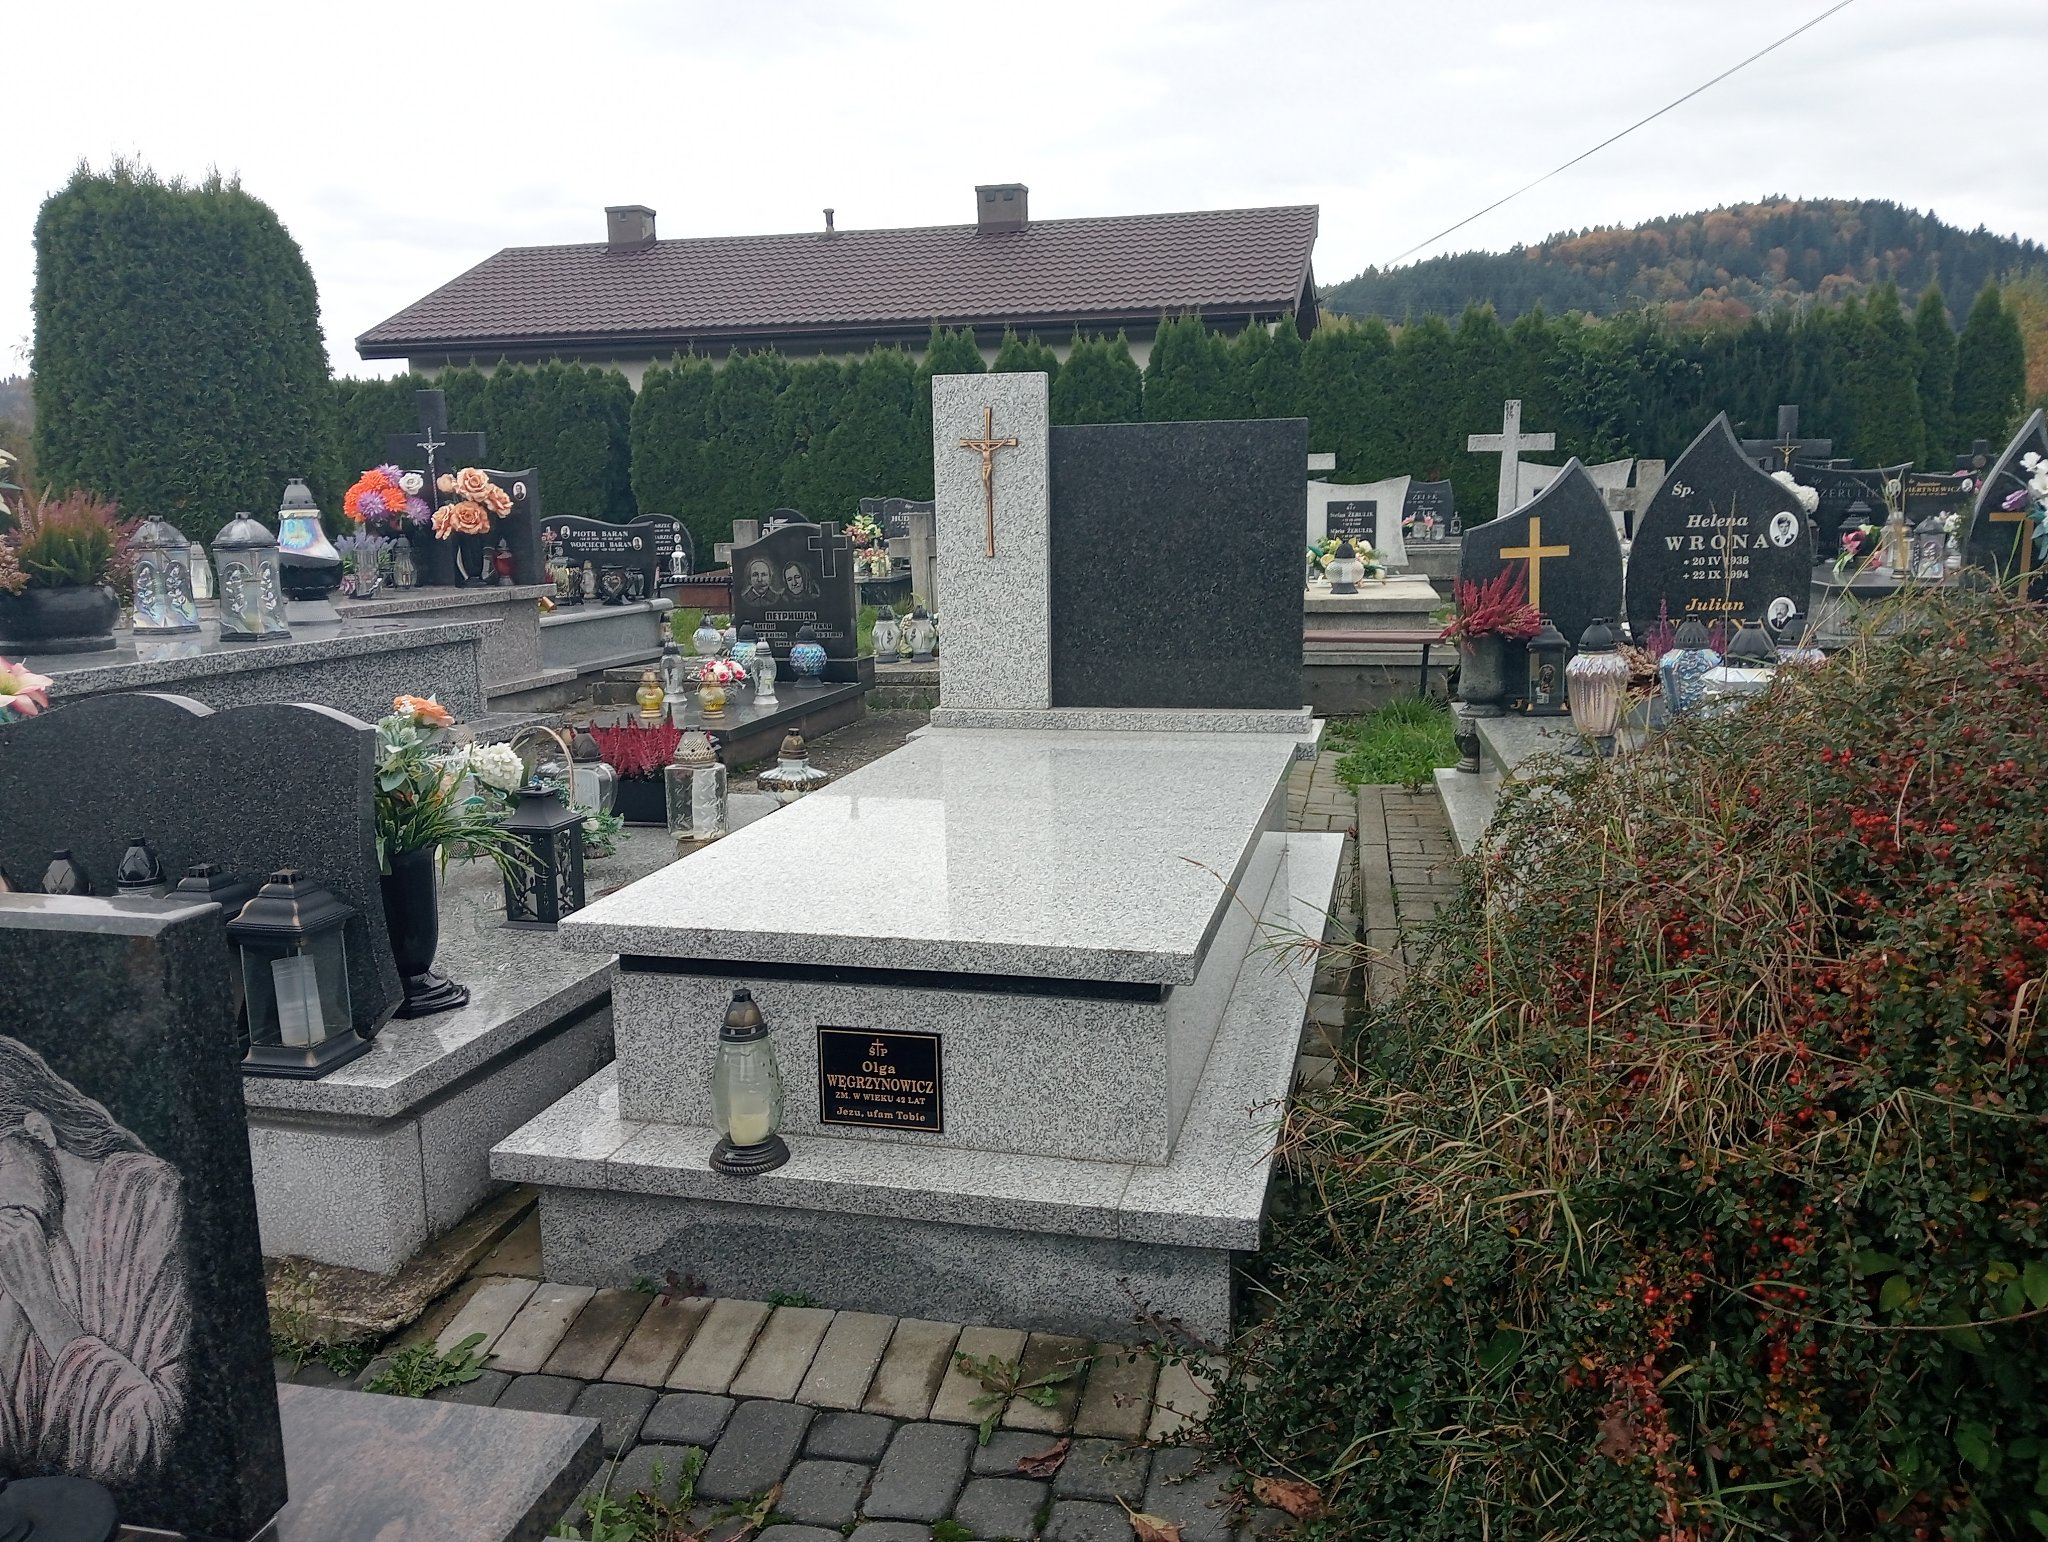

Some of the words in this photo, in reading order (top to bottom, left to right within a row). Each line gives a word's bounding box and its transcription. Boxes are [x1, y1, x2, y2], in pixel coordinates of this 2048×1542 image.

[1671, 481, 1695, 498] Śp.
[1686, 514, 1749, 528] Helena
[1665, 533, 1770, 551] WRONA
[1692, 556, 1705, 566] 20
[1708, 555, 1722, 566] IV
[1692, 570, 1705, 580] 22
[1708, 570, 1722, 580] IX
[1685, 598, 1744, 612] Julian
[765, 611, 817, 621] ПЕТРИШАК
[862, 1061, 896, 1076] Olga
[826, 1073, 934, 1094] WĘGRZYNOWICZ
[835, 1091, 851, 1100] ZM.
[853, 1092, 861, 1100] W
[863, 1093, 894, 1103] WIEKU
[895, 1096, 906, 1104] 42
[907, 1096, 926, 1105] LAT
[836, 1106, 864, 1118] Jezu,
[866, 1109, 894, 1119] ufam
[895, 1110, 926, 1122] Tobie
